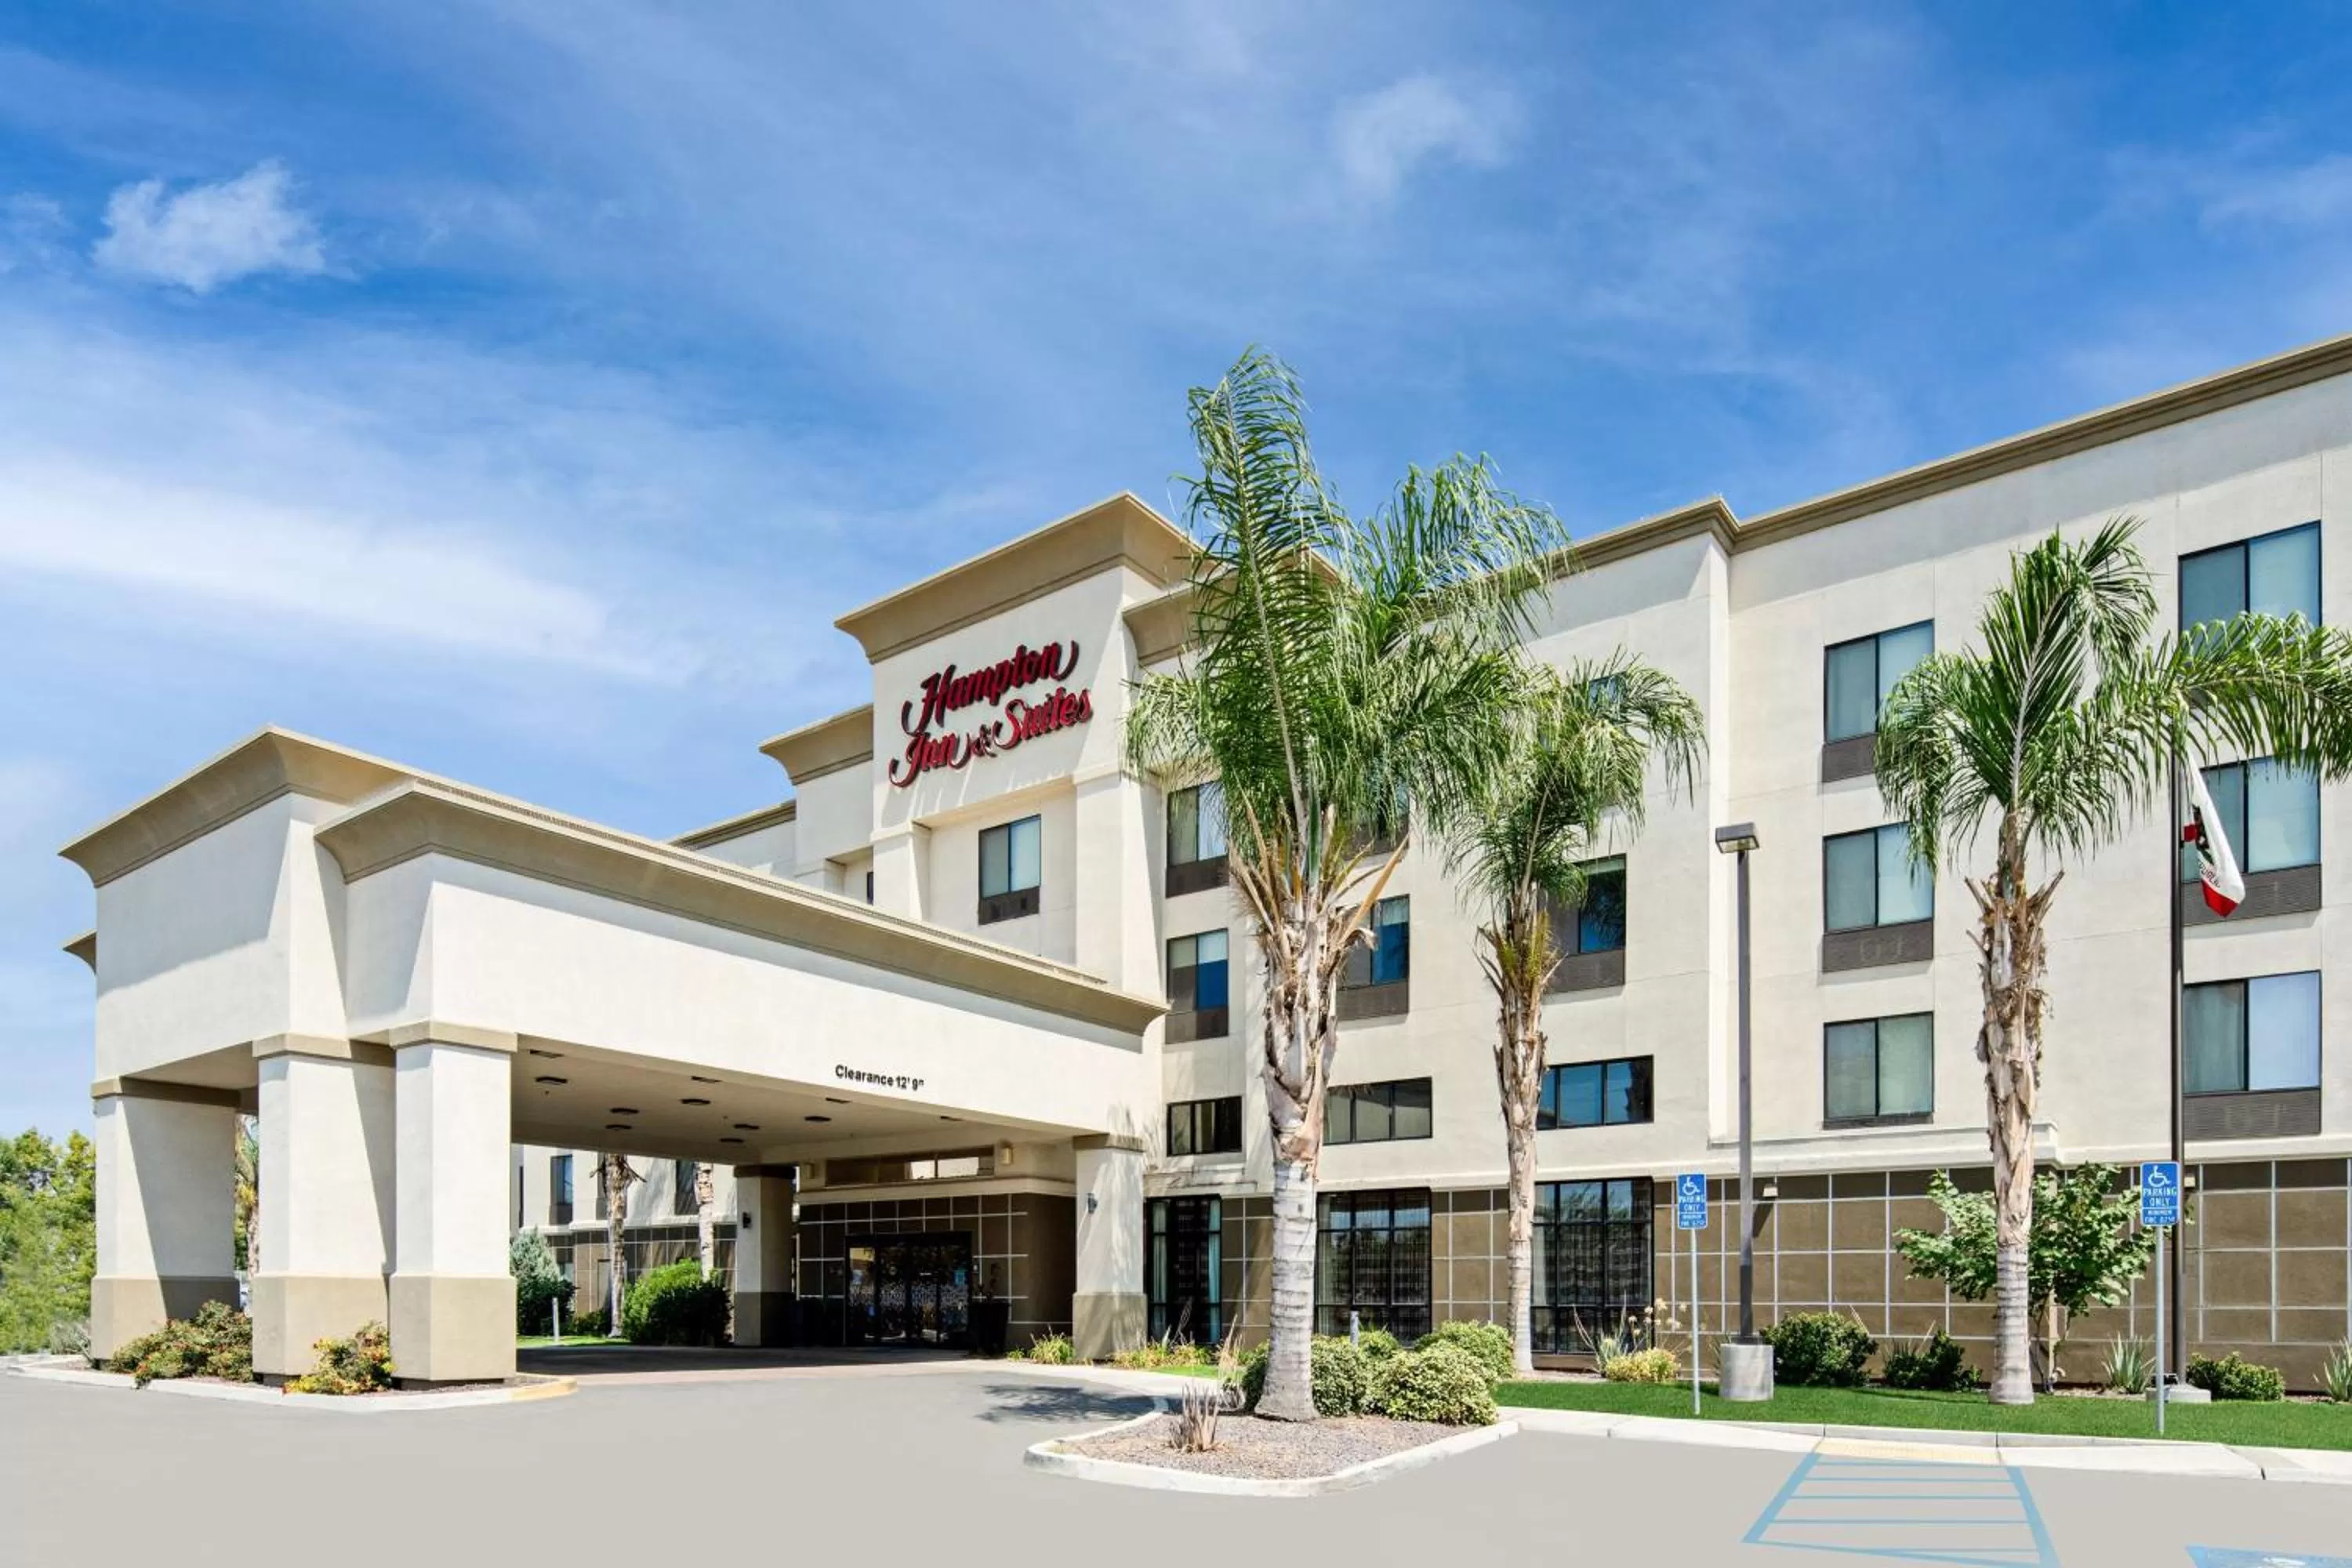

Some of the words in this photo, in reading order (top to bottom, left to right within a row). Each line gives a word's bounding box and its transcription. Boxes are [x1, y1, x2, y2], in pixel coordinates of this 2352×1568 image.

[902, 640, 1080, 737] Hampton
[888, 732, 972, 788] Inn
[971, 723, 997, 758] &
[993, 687, 1094, 750] Suites
[835, 1064, 895, 1087] Clearance
[896, 1075, 910, 1090] 12'
[2143, 1187, 2177, 1197] PARKING
[2150, 1197, 2170, 1207] ONLY
